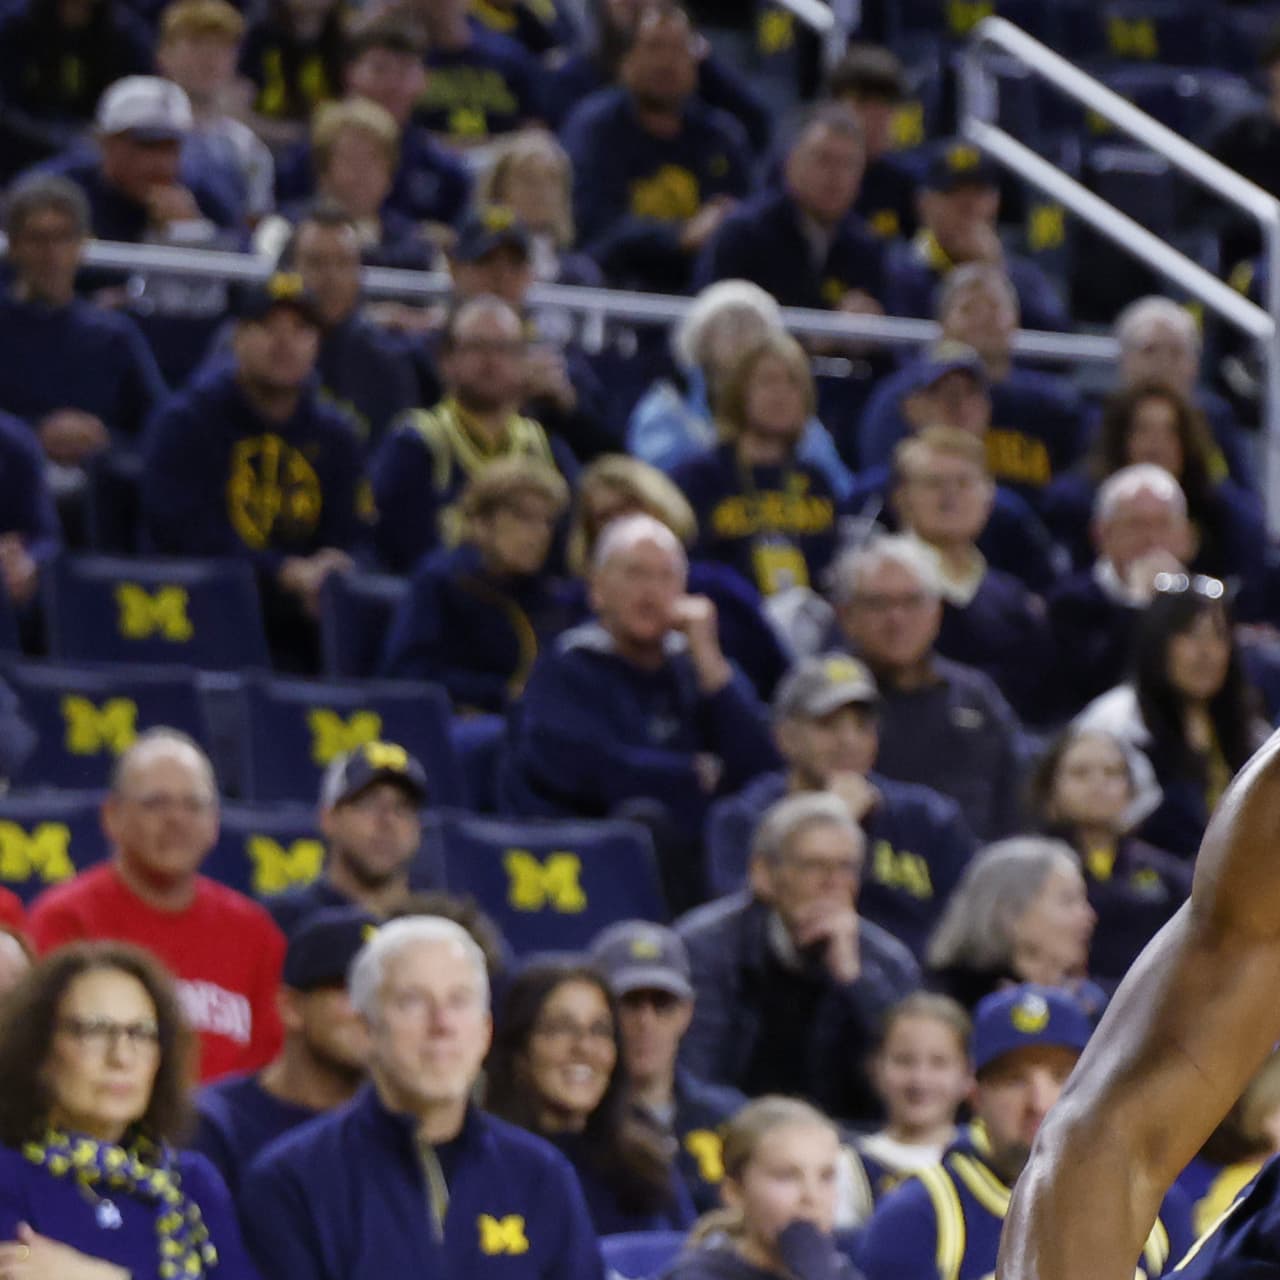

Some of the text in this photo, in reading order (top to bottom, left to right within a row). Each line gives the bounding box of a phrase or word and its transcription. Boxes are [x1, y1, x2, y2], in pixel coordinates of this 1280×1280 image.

[117, 584, 193, 641] M
[64, 697, 138, 755] M
[309, 710, 383, 765] M
[0, 821, 75, 882] M
[249, 838, 326, 892] M
[505, 851, 586, 912] M
[478, 1213, 530, 1255] M
